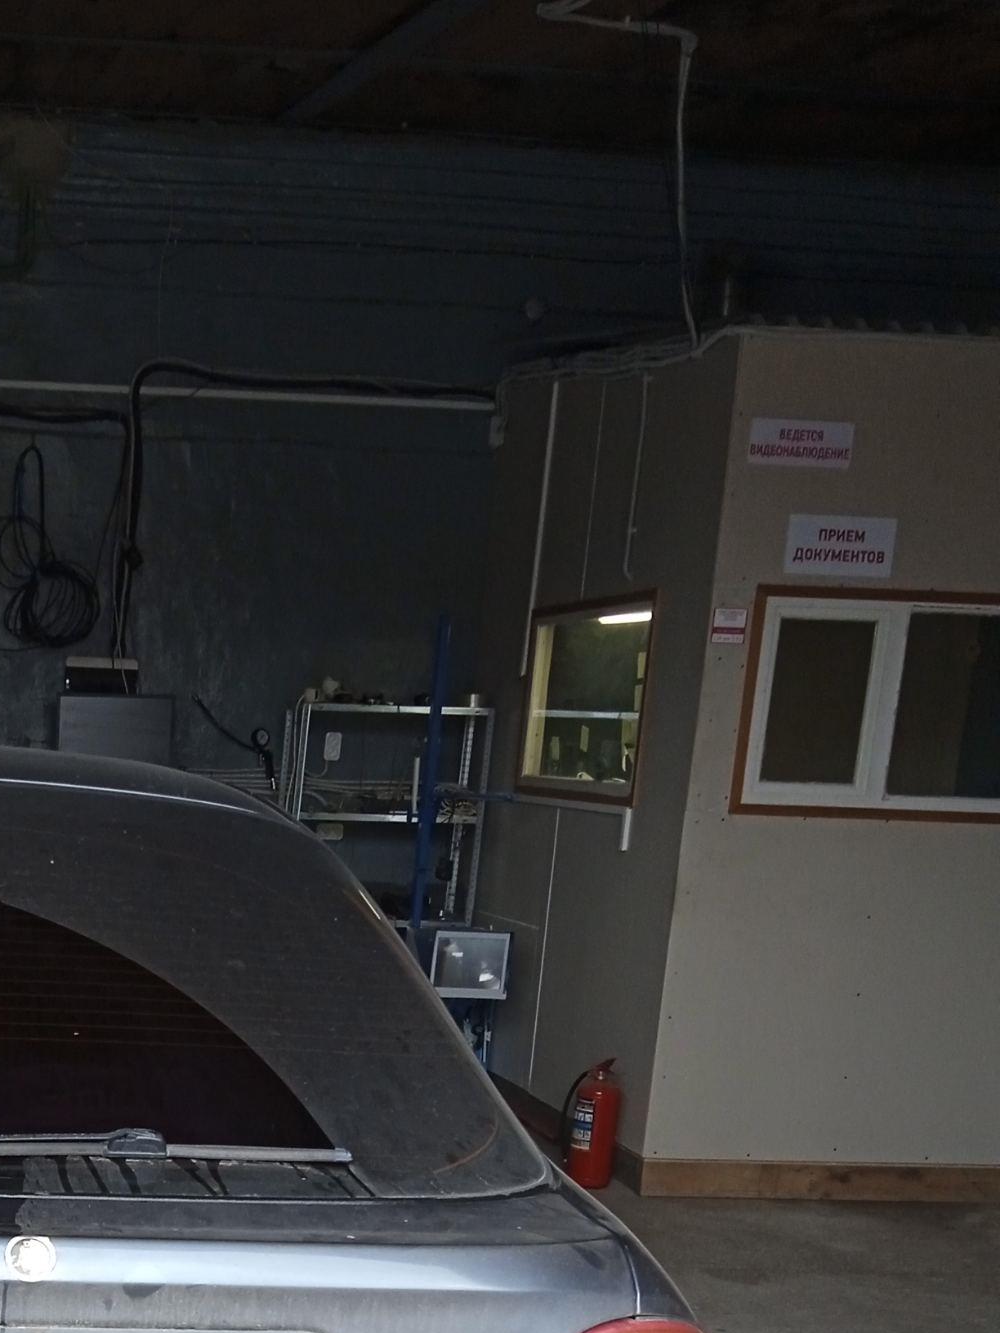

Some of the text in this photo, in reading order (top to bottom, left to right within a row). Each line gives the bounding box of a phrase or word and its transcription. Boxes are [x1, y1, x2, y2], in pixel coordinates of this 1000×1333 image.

[779, 428, 825, 443] ВЕДЕТСЯ
[749, 443, 850, 461] ВИДЕОНАБЛЮДЕНИЕ
[818, 528, 866, 544] ПРИЕМ
[792, 547, 886, 564] ДОКУМЕНТОВ
